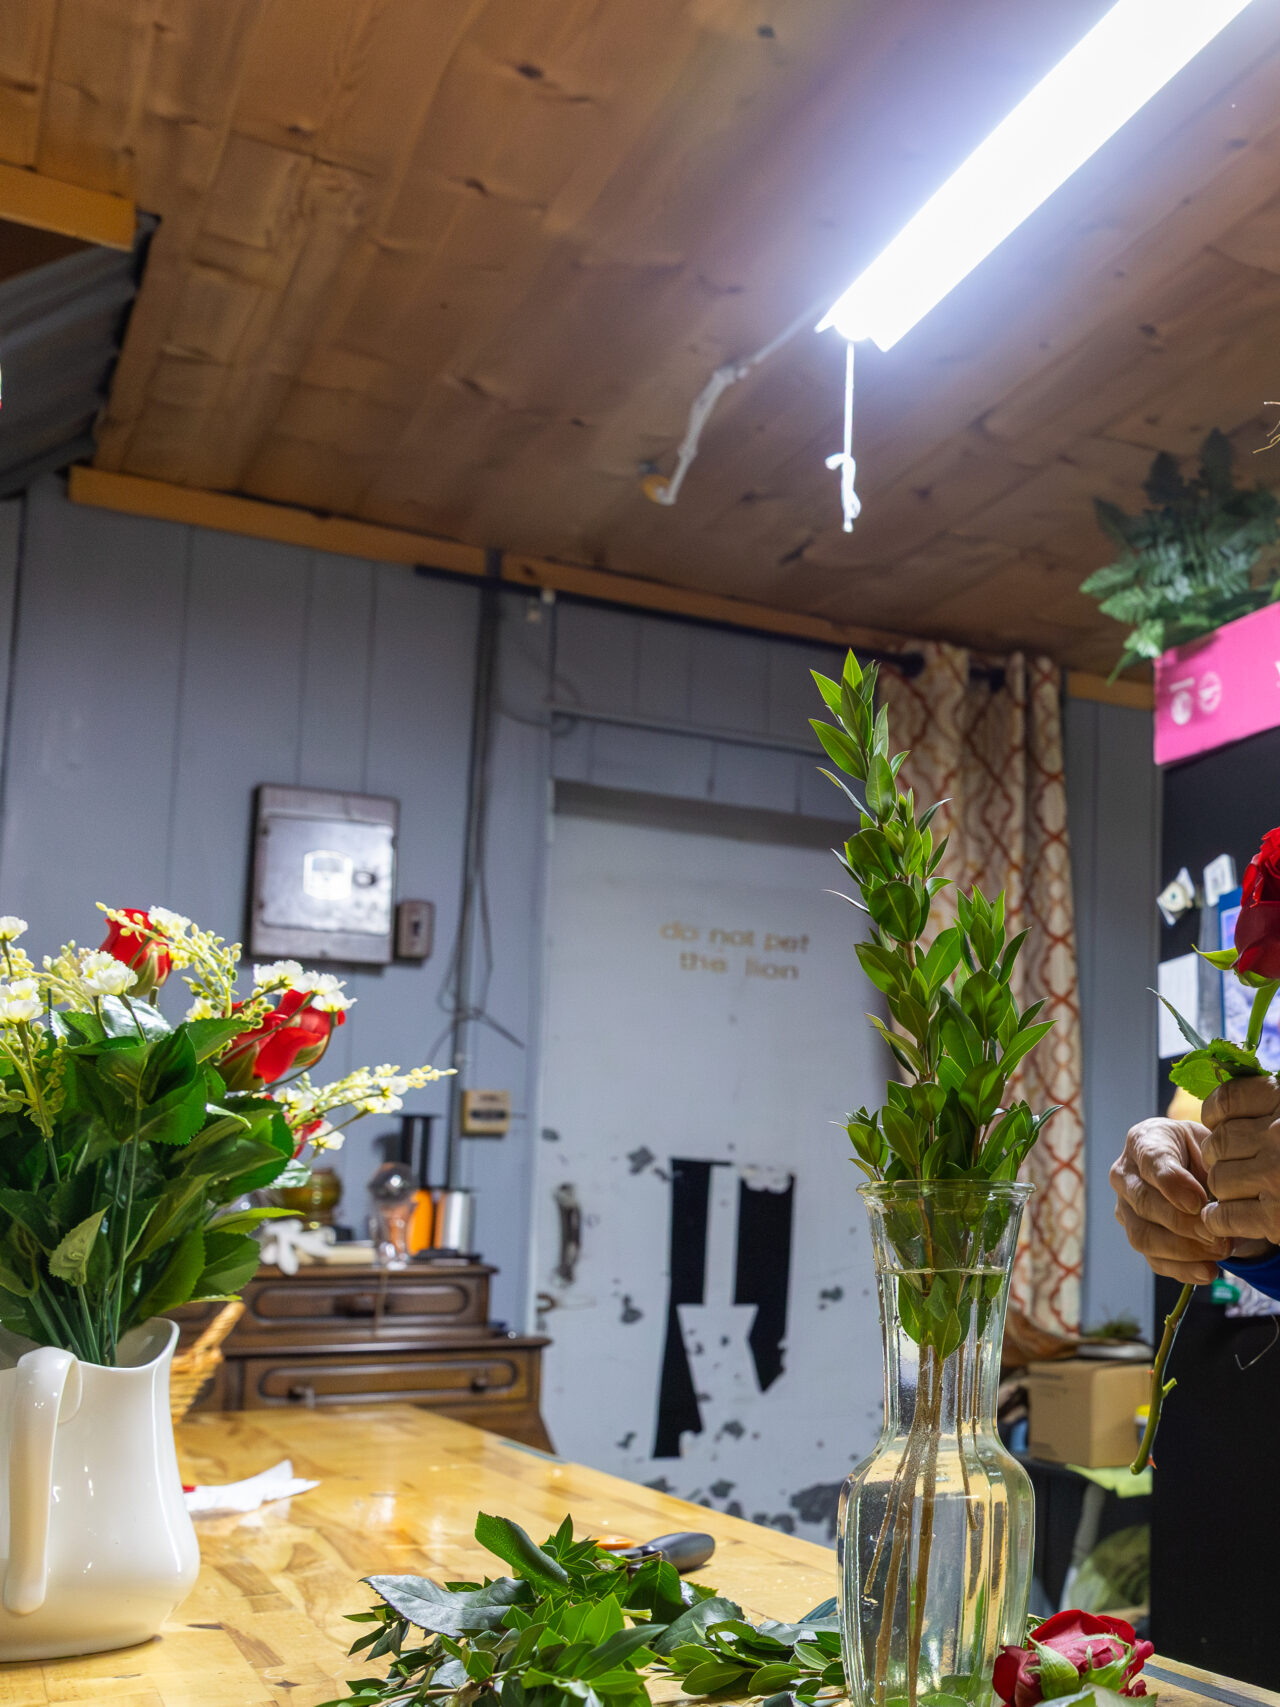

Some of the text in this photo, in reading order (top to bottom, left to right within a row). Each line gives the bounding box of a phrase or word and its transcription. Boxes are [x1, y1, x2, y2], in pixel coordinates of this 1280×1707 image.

[659, 920, 699, 942] do
[709, 927, 755, 947] not
[679, 951, 800, 980] the lion
